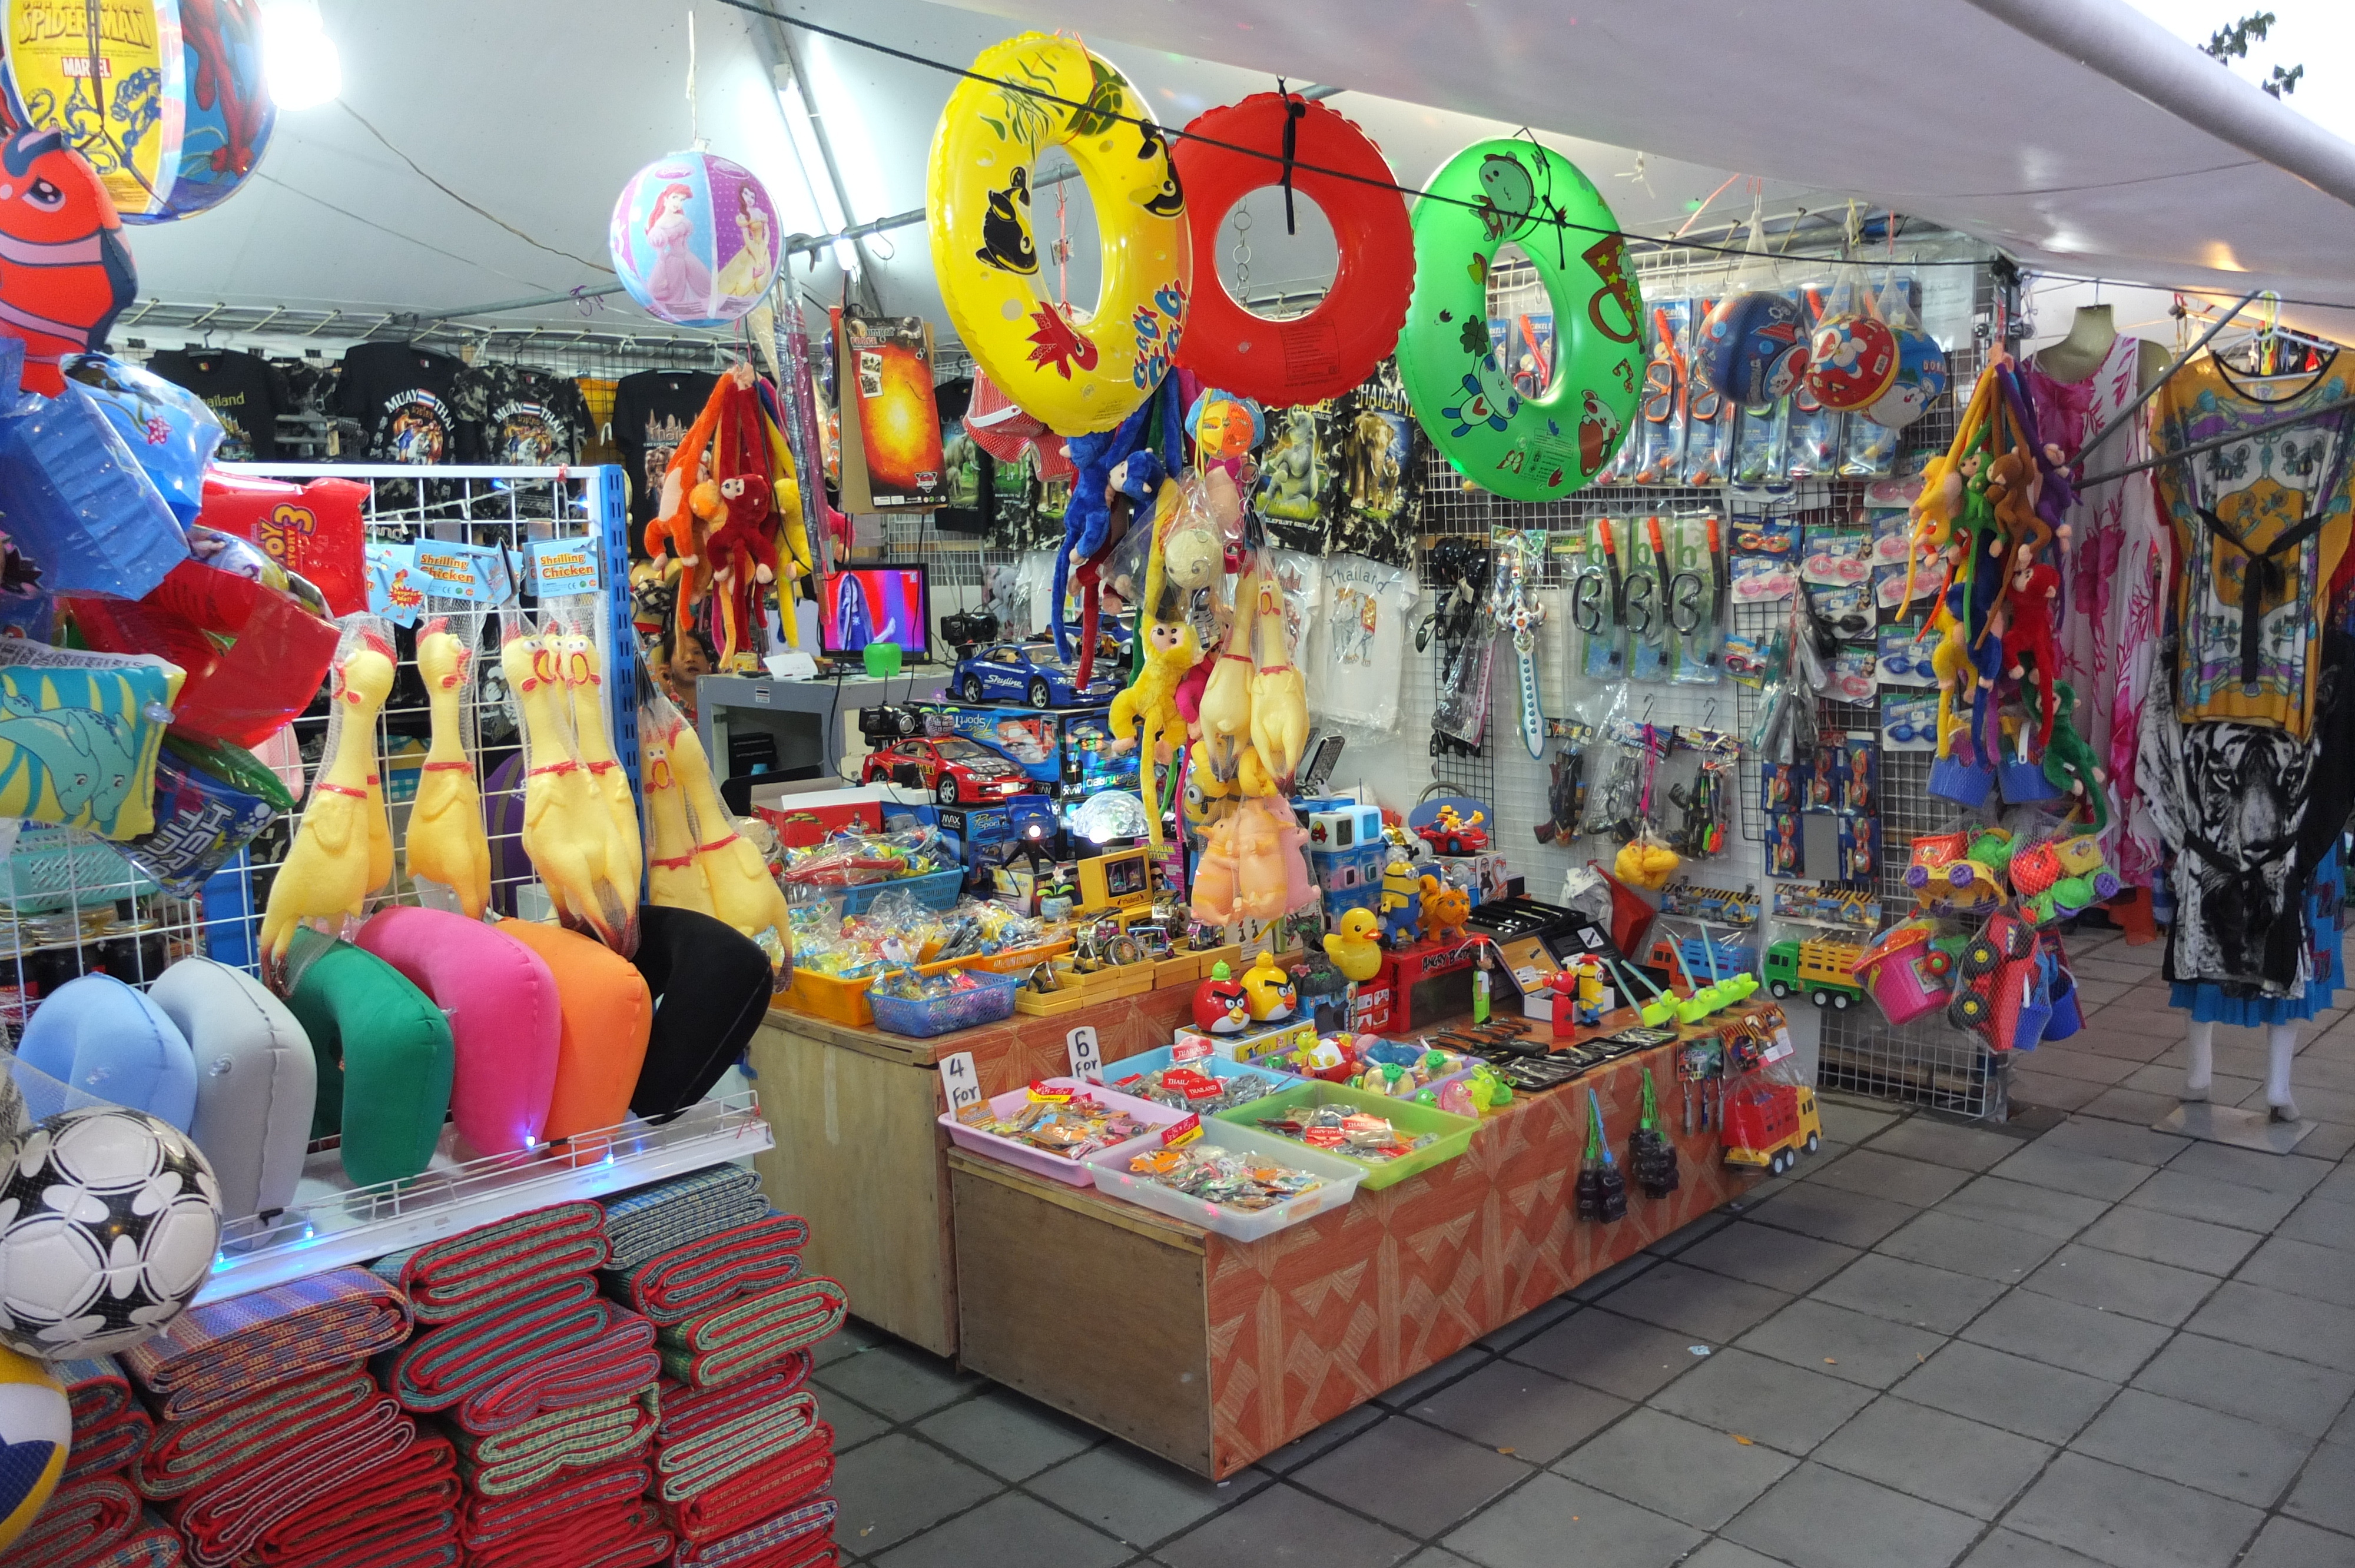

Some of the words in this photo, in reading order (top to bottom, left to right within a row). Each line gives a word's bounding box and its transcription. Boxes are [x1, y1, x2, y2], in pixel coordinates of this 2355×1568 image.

[19, 8, 152, 49] SPIDERMAN
[62, 58, 110, 78] MAREL
[384, 389, 418, 413] MUAY
[434, 398, 455, 431] THAI
[492, 402, 523, 423] MUAY
[539, 407, 565, 433] THAI
[271, 503, 317, 537] 3
[257, 517, 287, 562] OY
[420, 553, 470, 572] Shrilling
[540, 553, 586, 566] Shrilling
[542, 564, 595, 580] Chicken
[1325, 566, 1391, 594] Thailand
[984, 675, 1024, 689] Skyline
[941, 813, 961, 825] MAX
[1422, 952, 1448, 974] ANGRY
[1074, 1030, 1090, 1057] 6
[1178, 1045, 1208, 1058] THAILAND
[949, 1058, 964, 1078] 4
[1189, 1084, 1218, 1095] THAILAND
